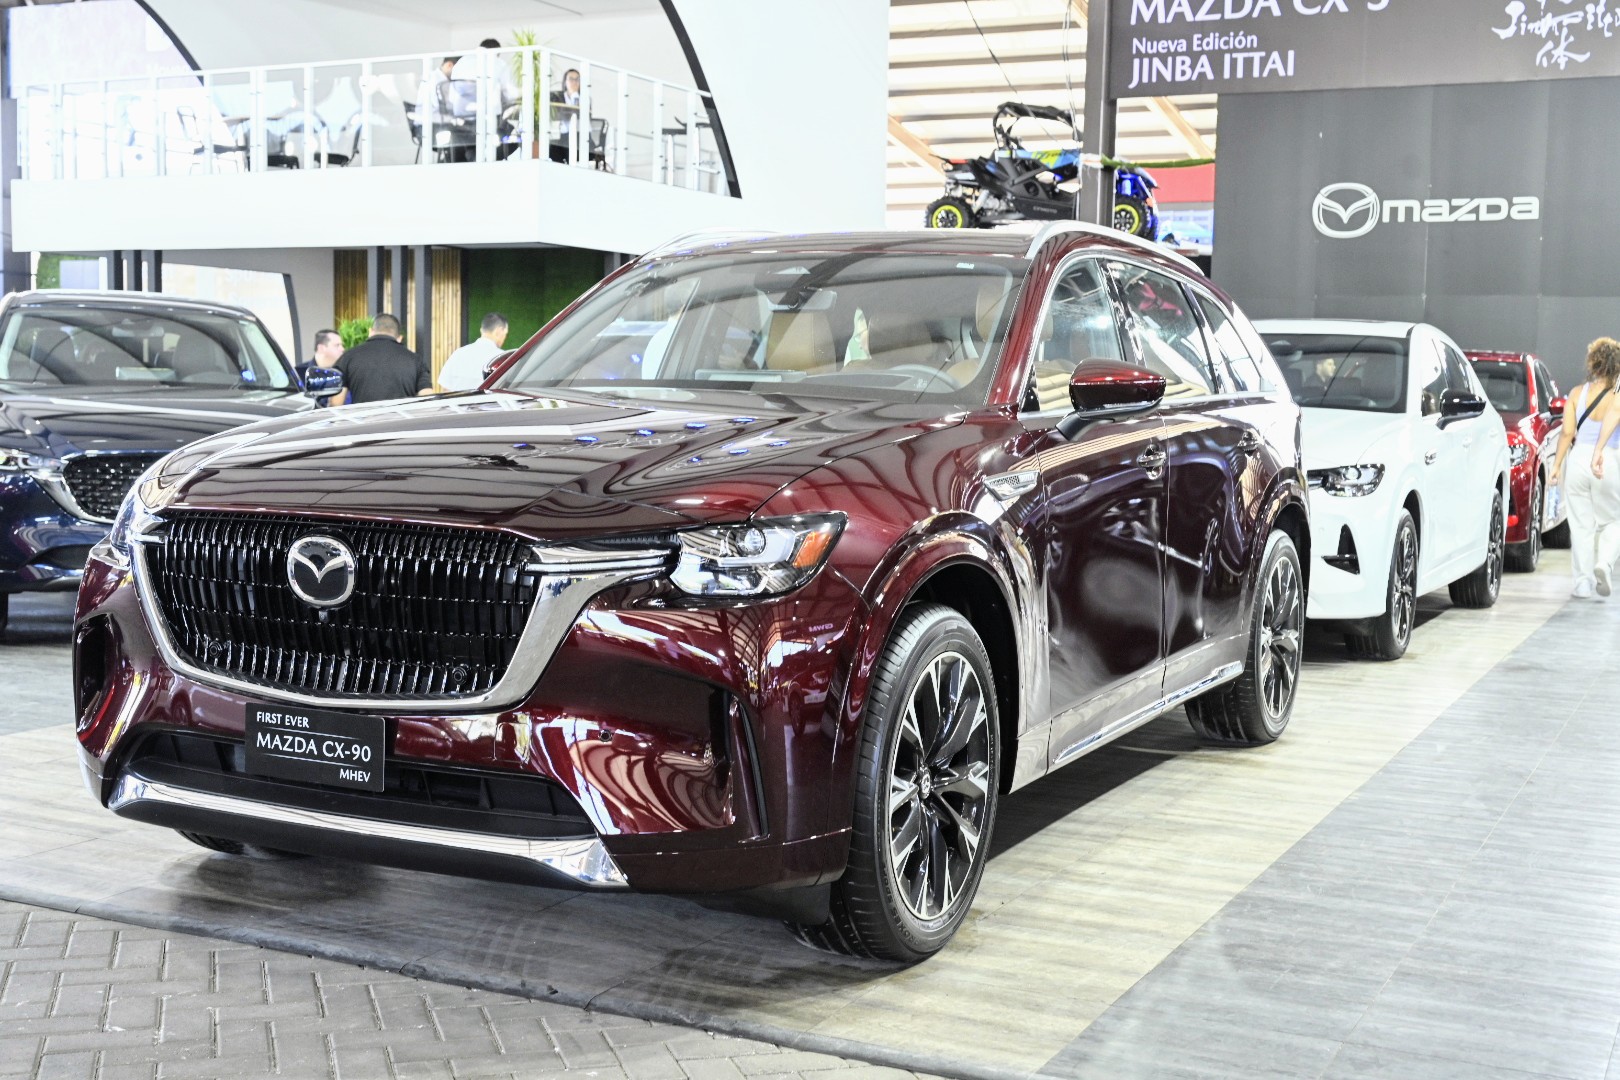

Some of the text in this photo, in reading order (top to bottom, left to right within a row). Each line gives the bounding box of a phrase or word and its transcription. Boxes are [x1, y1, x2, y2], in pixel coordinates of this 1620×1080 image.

[1130, 0, 1282, 25] MAZDA
[1132, 31, 1258, 54] Nueva Edición
[1128, 50, 1295, 89] JINBA ITTAI
[1381, 196, 1540, 224] mazda
[256, 711, 310, 729] FIRST EVER
[256, 731, 372, 763] MAZDA CX-90
[339, 768, 371, 783] MHEV
